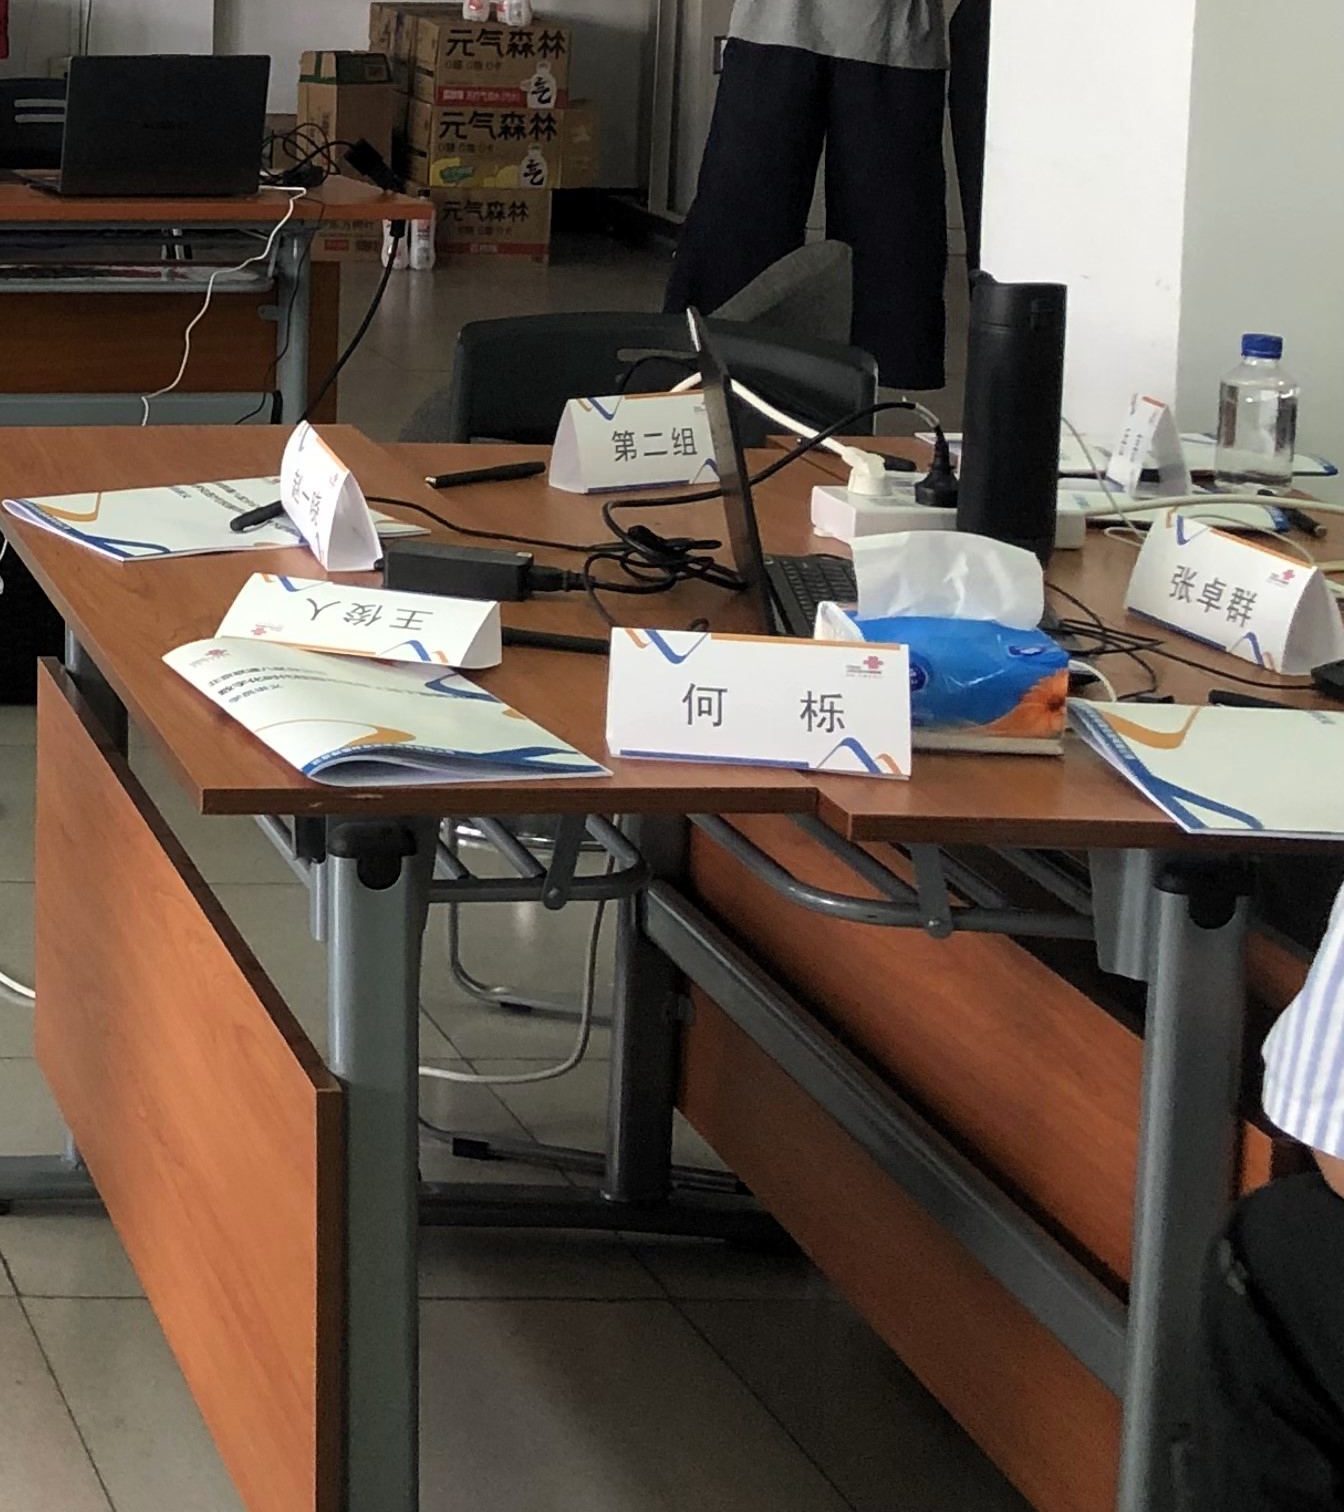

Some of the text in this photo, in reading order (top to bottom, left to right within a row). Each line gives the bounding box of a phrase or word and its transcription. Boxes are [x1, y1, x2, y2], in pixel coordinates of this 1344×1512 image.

[445, 27, 566, 60] 元气森林
[439, 110, 558, 142] 元气森林
[441, 199, 529, 223] 元气森林
[611, 426, 698, 463] 第二组
[1168, 564, 1258, 629] 张卓群
[306, 597, 434, 631] 王俊人
